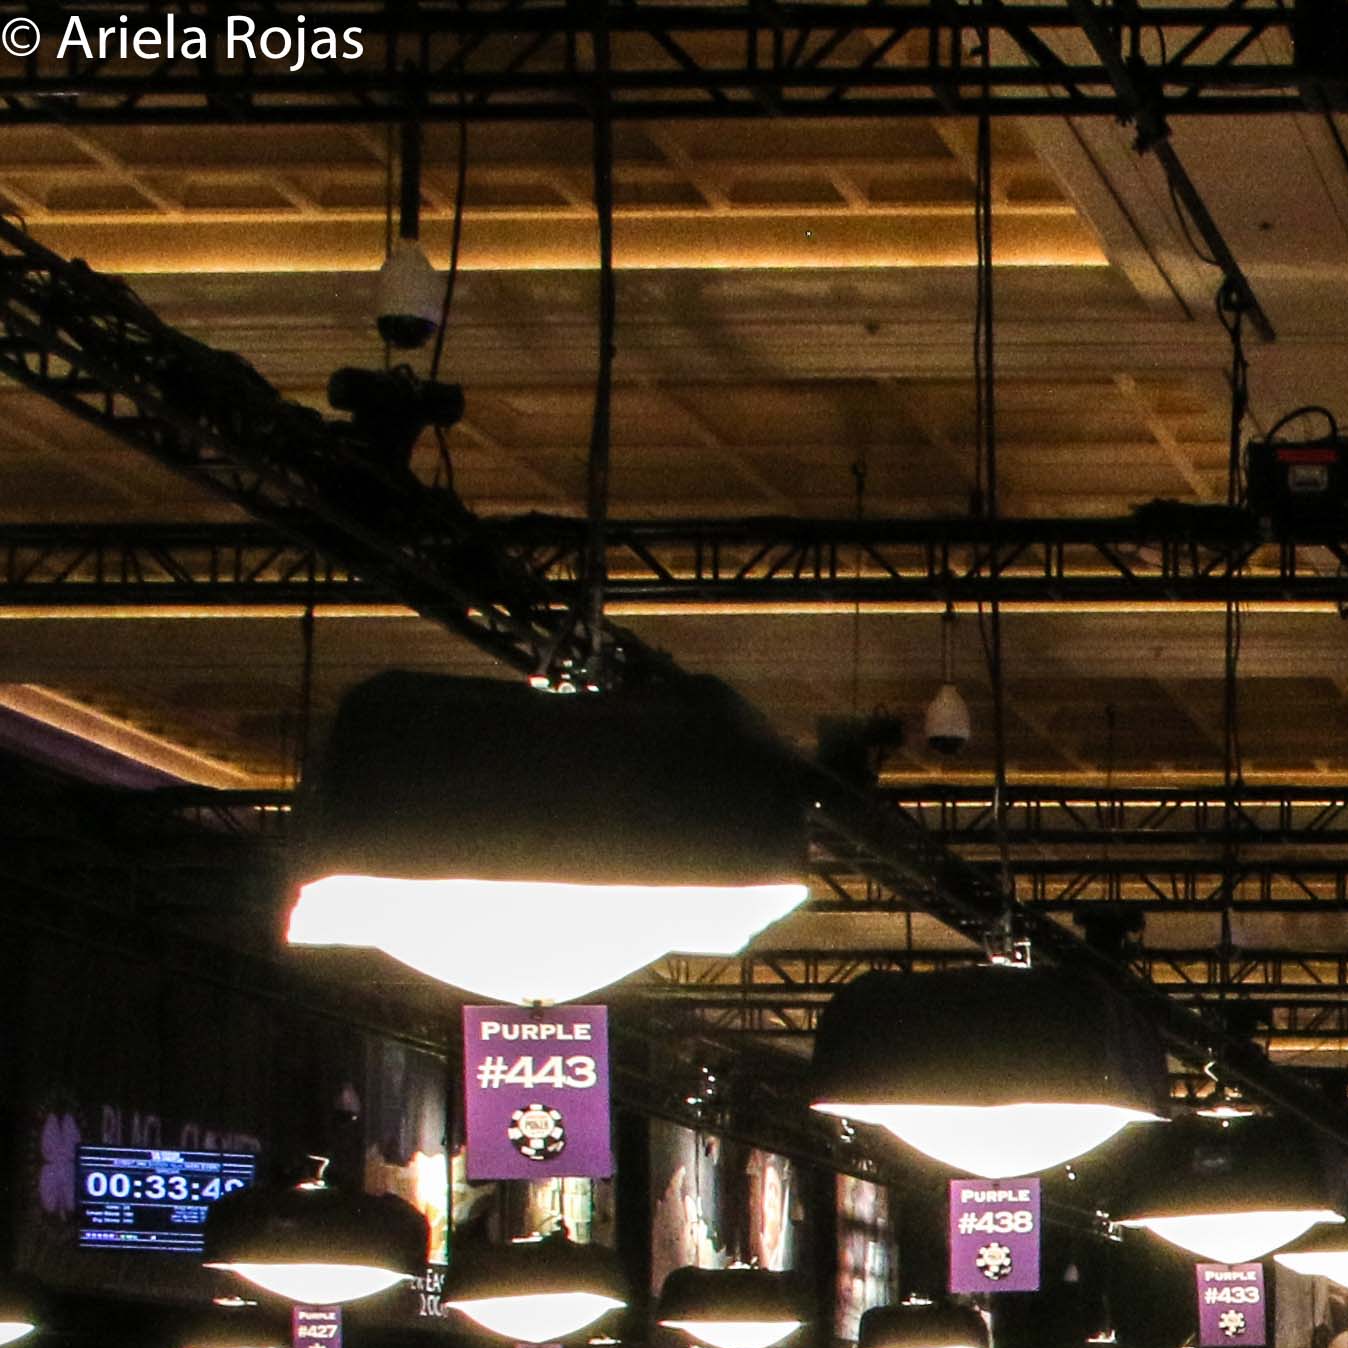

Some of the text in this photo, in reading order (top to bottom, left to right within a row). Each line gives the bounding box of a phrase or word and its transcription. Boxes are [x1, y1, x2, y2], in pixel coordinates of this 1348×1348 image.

[480, 1021, 592, 1041] PURPLE
[476, 1055, 598, 1089] #443
[86, 1172, 246, 1200] 00:33:4
[961, 1189, 1031, 1203] PURPLE
[958, 1211, 1034, 1234] #438
[1204, 1271, 1257, 1281] PURPLE
[1204, 1286, 1260, 1304] #433
[298, 1311, 336, 1320] PURPLE
[298, 1324, 338, 1338] #427
